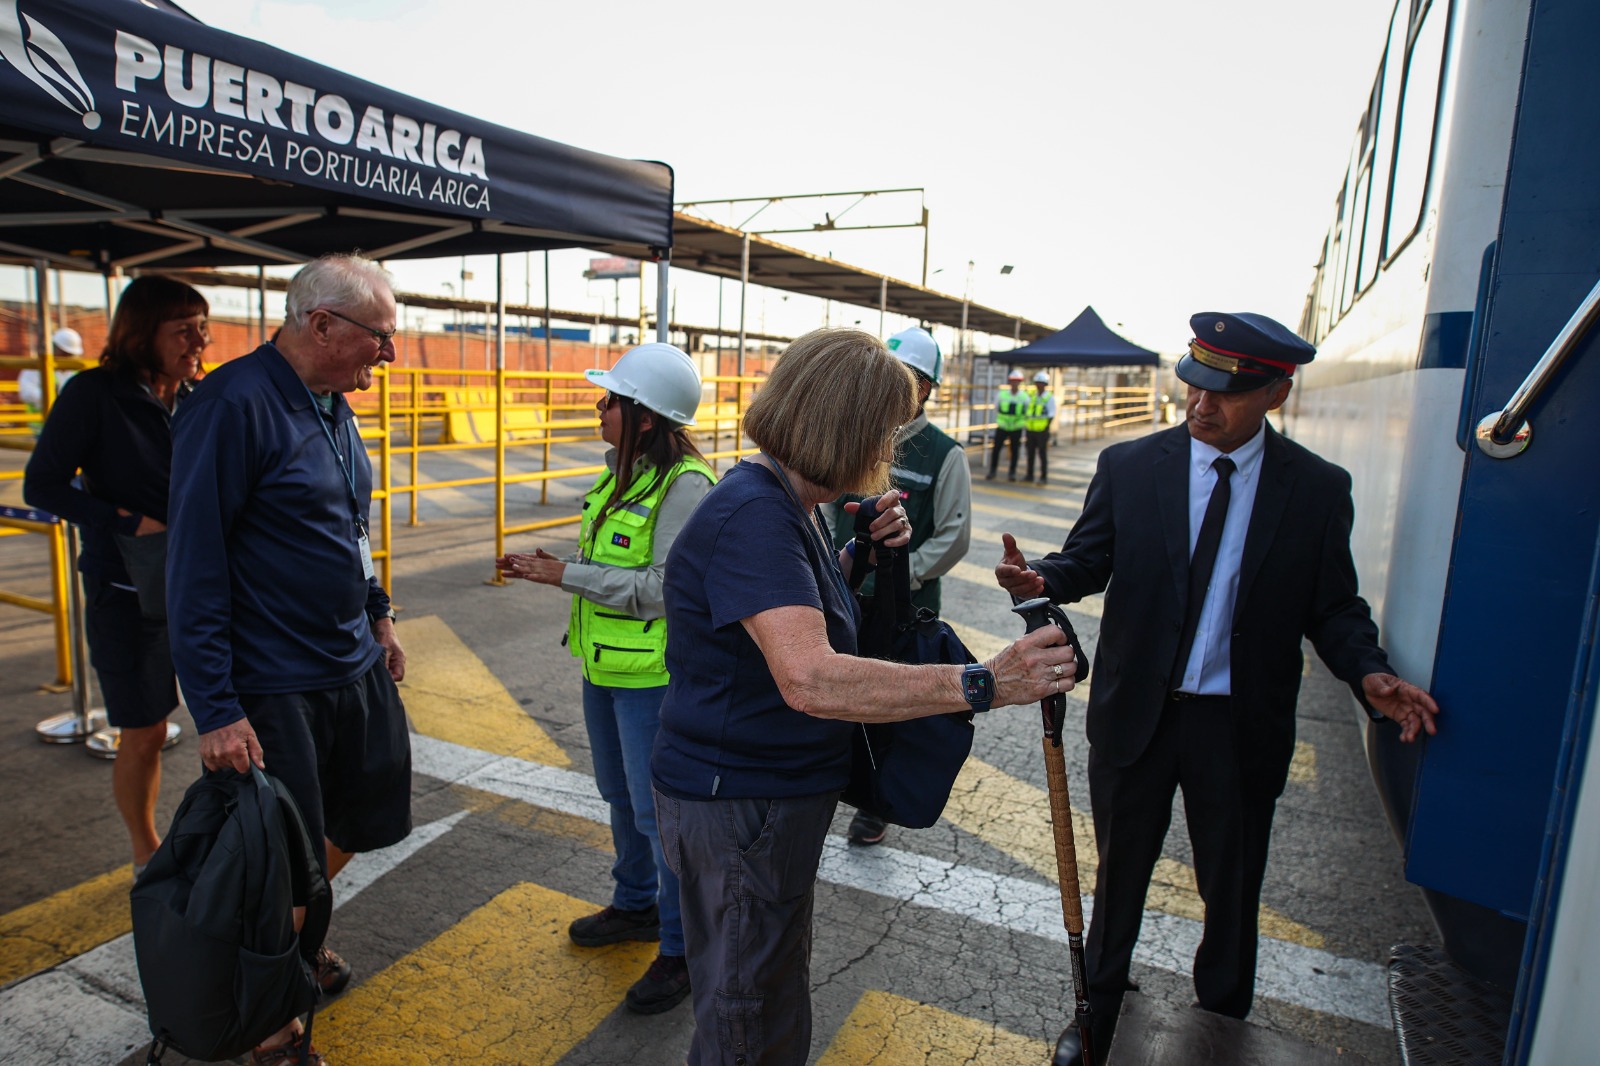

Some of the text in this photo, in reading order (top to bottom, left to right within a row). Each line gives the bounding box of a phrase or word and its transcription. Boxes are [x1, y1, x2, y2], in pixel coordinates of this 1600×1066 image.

[114, 29, 490, 181] PUERTOARICA
[119, 99, 491, 212] EMPRESA PORTUARIA ARICA
[613, 535, 628, 546] SAG
